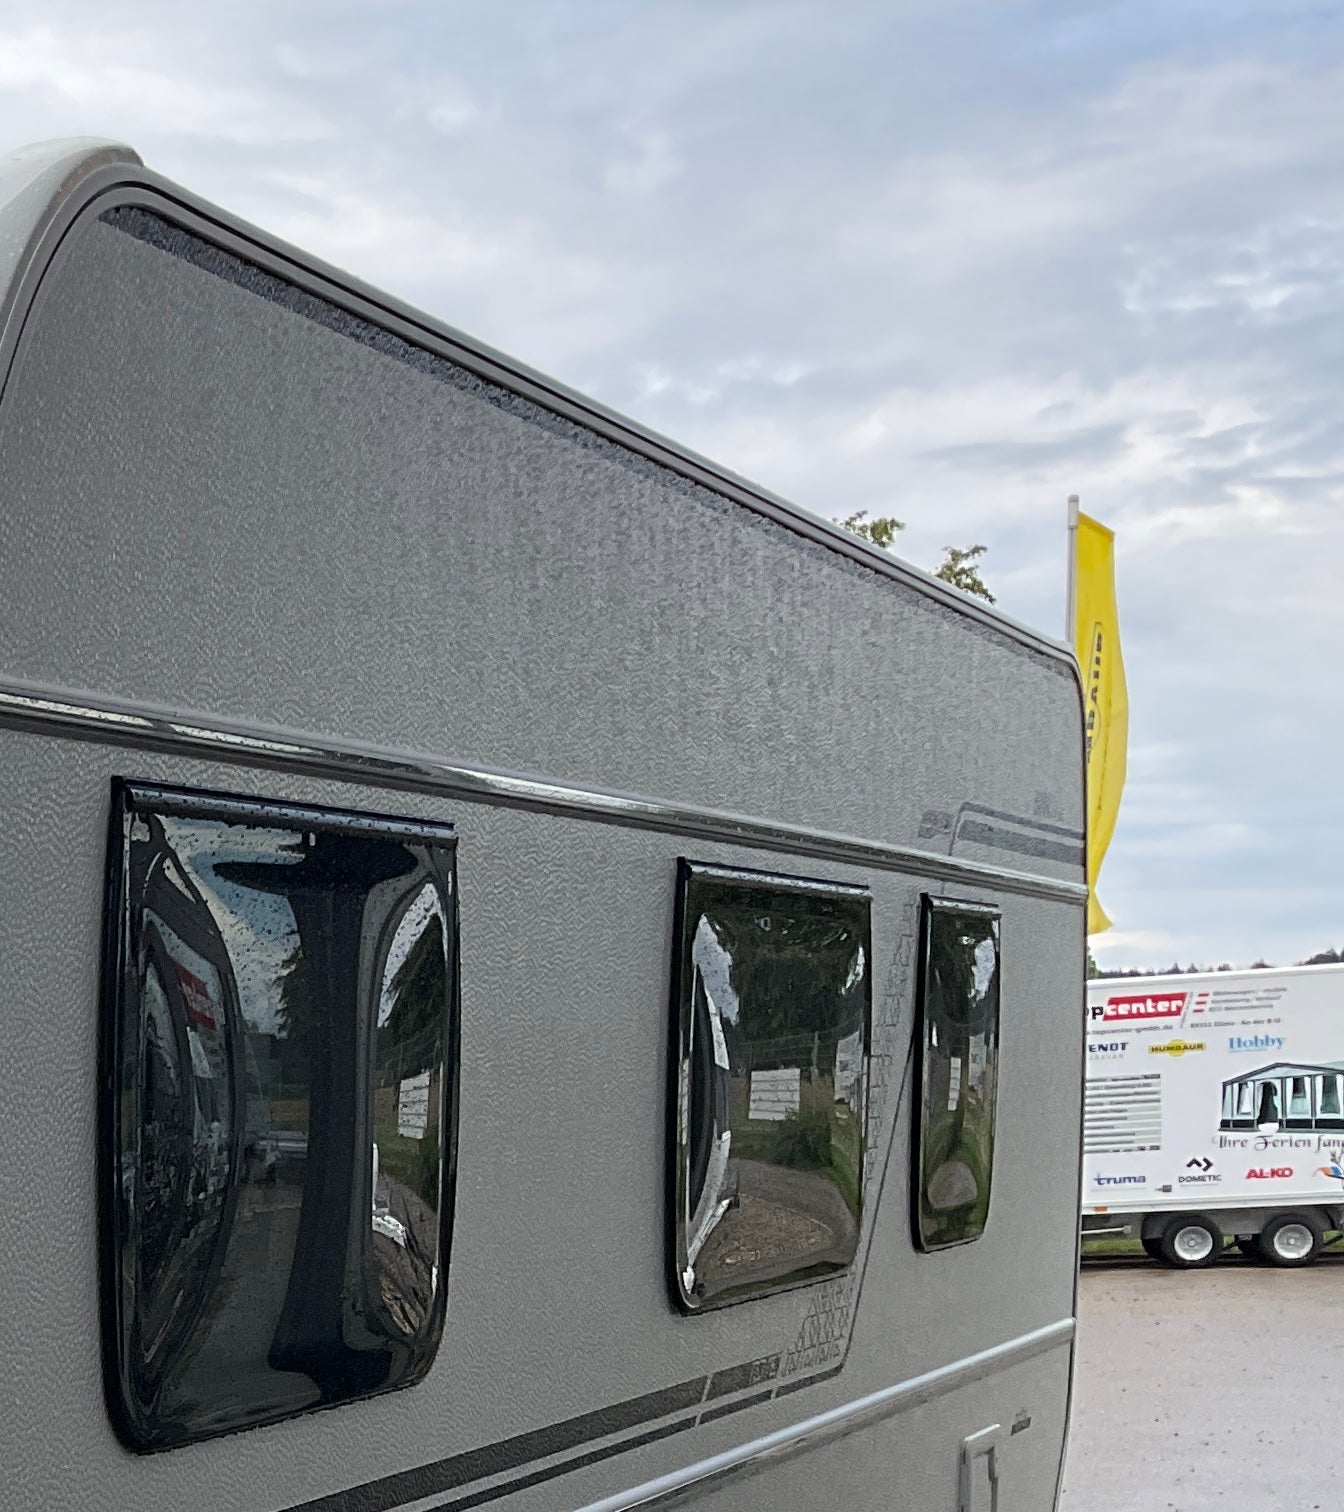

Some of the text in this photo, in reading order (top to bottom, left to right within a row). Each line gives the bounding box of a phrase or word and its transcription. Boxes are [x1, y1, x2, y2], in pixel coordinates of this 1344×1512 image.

[1087, 998, 1183, 1020] pcenter
[1229, 1035, 1285, 1050] Hobby
[1254, 1134, 1311, 1151] Ferien
[1094, 1173, 1146, 1185] truma
[1178, 1174, 1222, 1183] DOMETIC
